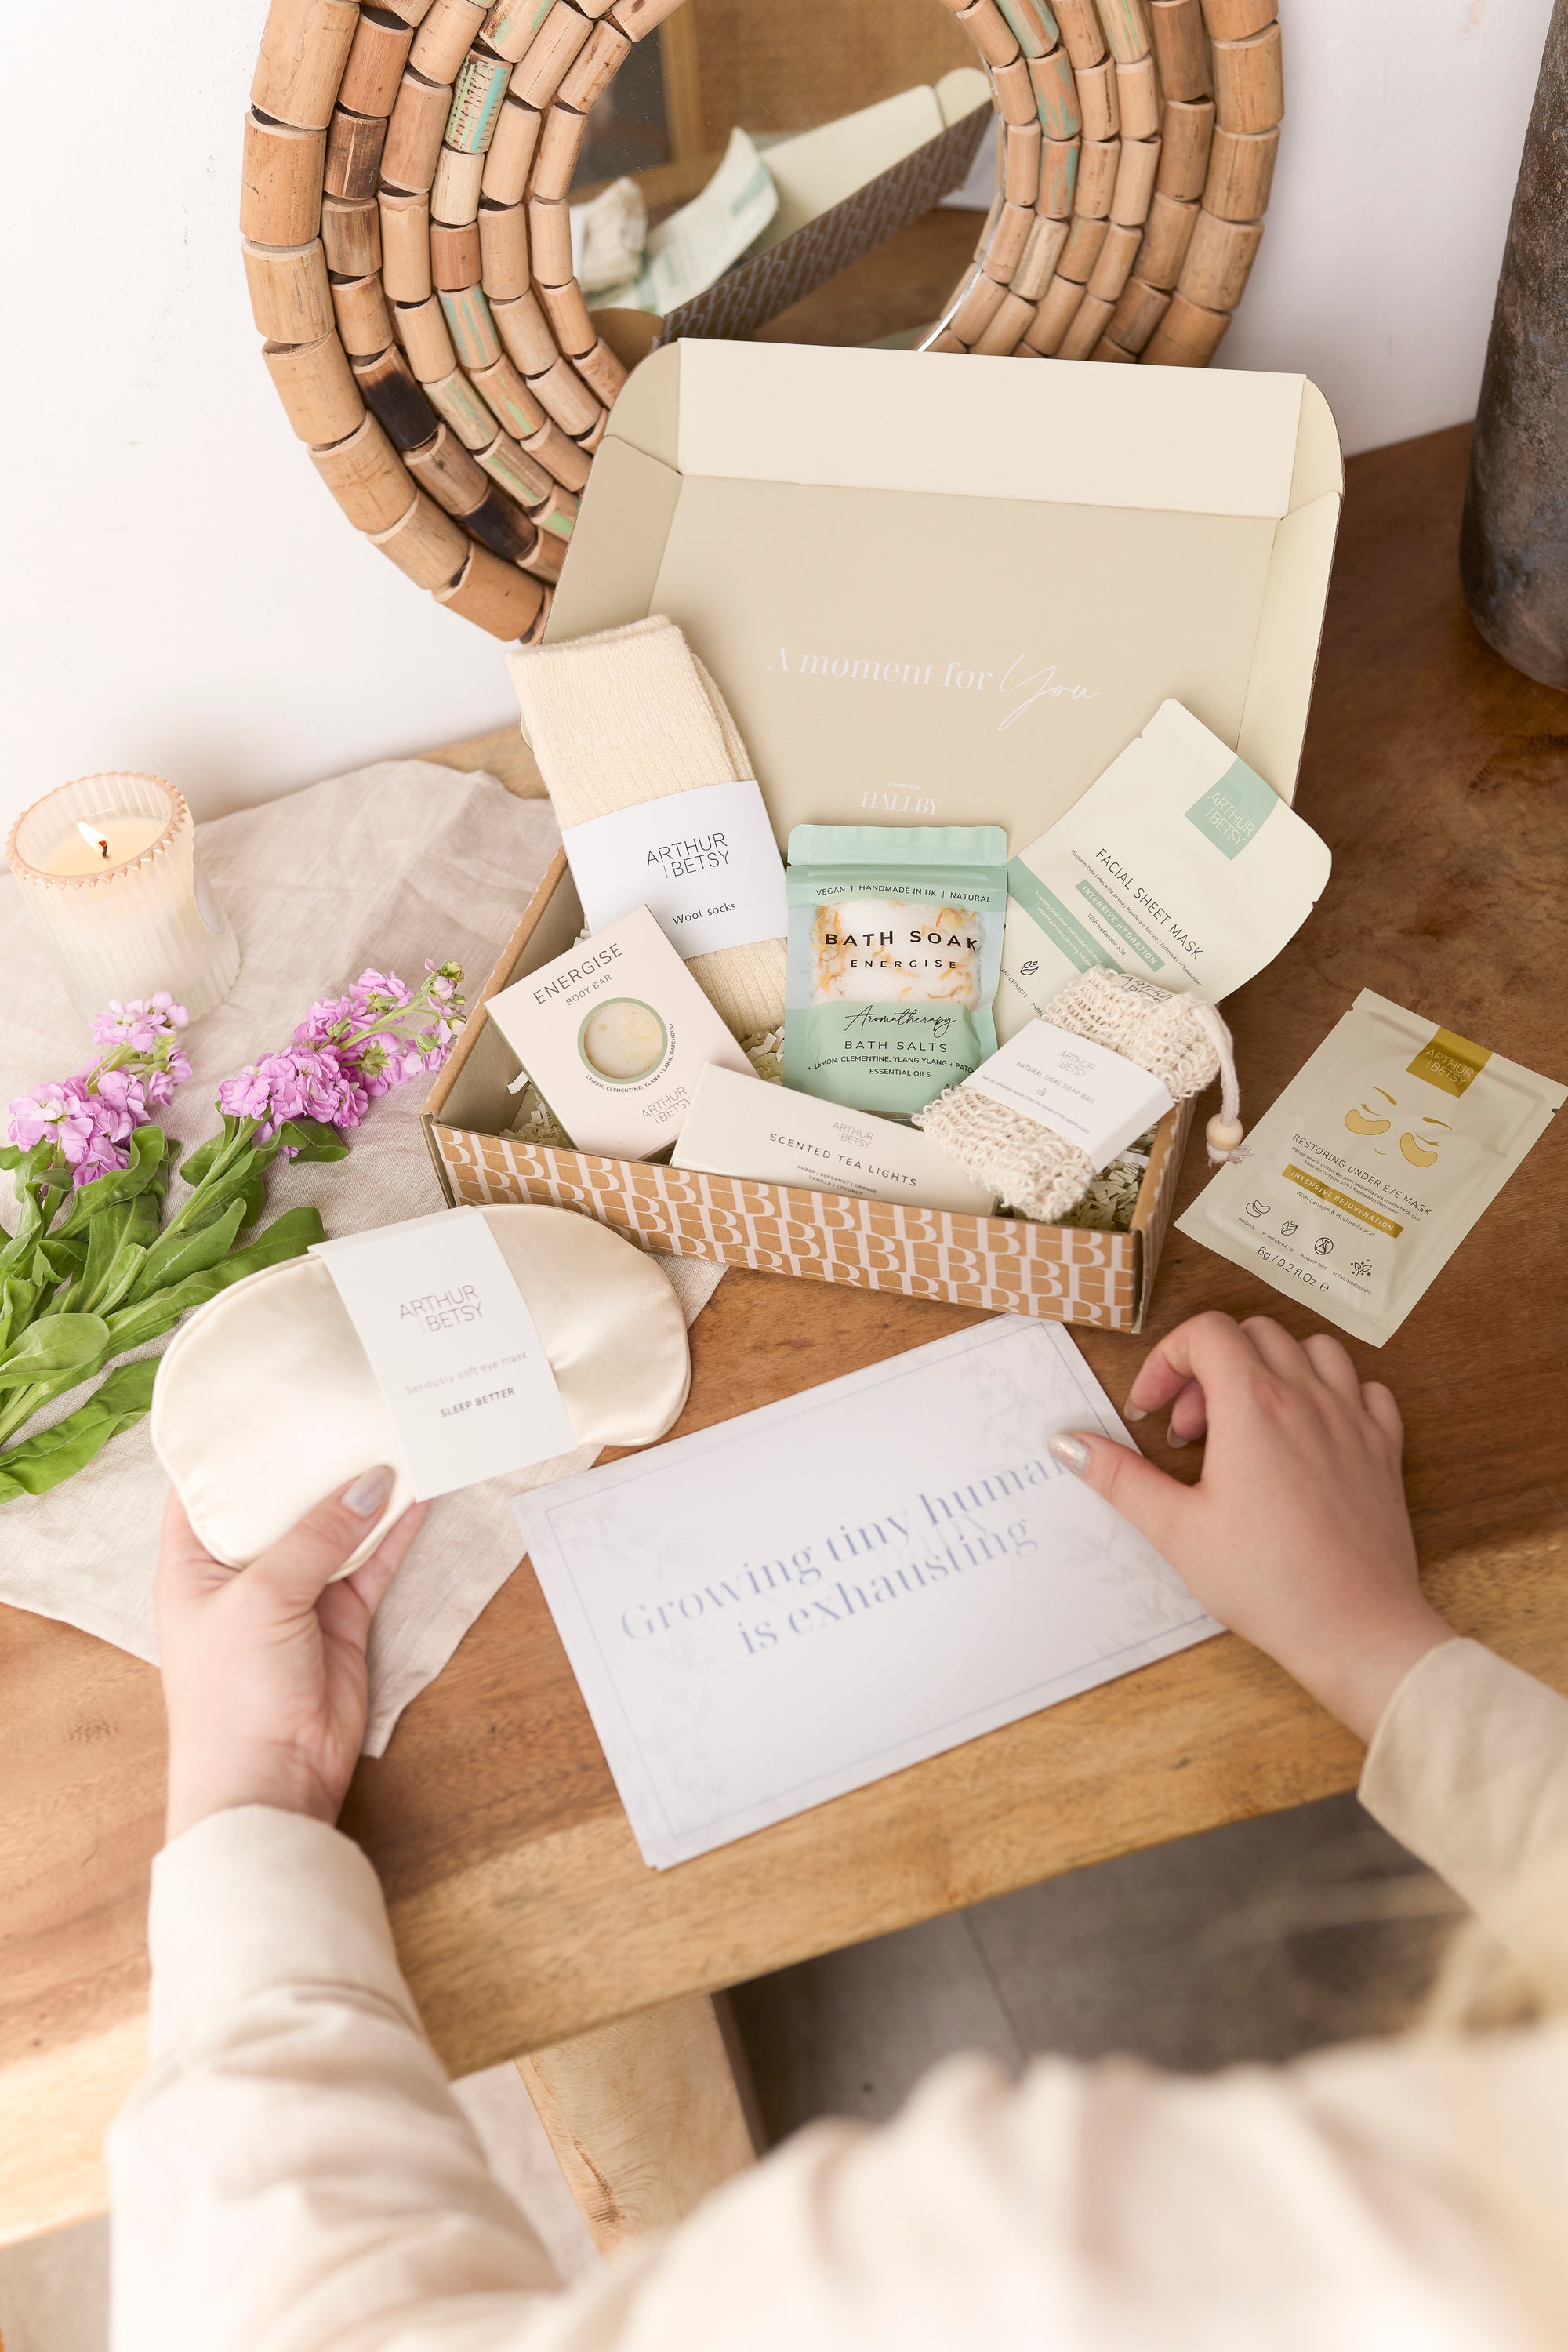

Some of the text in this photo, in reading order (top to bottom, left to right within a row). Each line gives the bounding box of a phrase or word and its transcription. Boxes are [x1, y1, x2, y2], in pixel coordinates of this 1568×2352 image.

[766, 647, 1100, 731] A moment for You
[859, 790, 944, 815] HALLBY
[1208, 792, 1254, 837] ARTHUR
[647, 833, 728, 866] ARTHUR
[815, 886, 845, 896] VEGAN
[858, 884, 910, 894] HANDMADE
[950, 892, 991, 902] NATURAL
[1095, 848, 1203, 960] FACIAL SHEET MASK
[672, 902, 736, 924] Wool socks
[1082, 886, 1118, 921] INTENSIVE
[1116, 922, 1157, 964] HYDRATION
[825, 930, 978, 953] BATH SOAK
[1087, 913, 1127, 956] With Hyaluronic acid
[533, 942, 624, 1004] ENERGISE
[851, 959, 956, 969] ENERGISE
[565, 974, 612, 1006] BODY BAR
[1008, 977, 1029, 998] EXTRACTS
[844, 1004, 957, 1039] Aromatherapy
[844, 1040, 948, 1053] BATH SALTS
[1058, 1051, 1096, 1072] ARTHUR
[814, 1057, 839, 1069] LEMON,
[921, 1058, 947, 1067] YLANG
[869, 1068, 931, 1078] ESSENTIAL OILS
[1059, 1061, 1089, 1077] BETSY
[1425, 1048, 1474, 1078] ARTHUR
[644, 1074, 662, 1087] YLANG
[1016, 1062, 1096, 1105] NATURAL SISAL SOAP BAG
[641, 1086, 688, 1120] ARTHUR
[831, 1122, 874, 1141] ARTHUR
[840, 1133, 873, 1149] BETSY
[769, 1133, 917, 1187] SCENTED TEA LIGHTS
[797, 1165, 877, 1194] AMBER BERGAMOT ORANGE
[808, 1175, 863, 1196] VANILLA COCONUT
[1292, 1134, 1432, 1217] RESTORING UNDER EYE MASK
[1291, 1171, 1394, 1231] INTENSIVE REJUVENATION
[1296, 1190, 1308, 1201] With
[1308, 1198, 1330, 1214] Collagen
[1336, 1213, 1363, 1231] Hyaluronic
[1363, 1228, 1374, 1236] acid
[1238, 1218, 1255, 1229] PATCHES
[1262, 1232, 1294, 1252] PLANT EXTRACTS
[1258, 1247, 1271, 1261] 6g
[1277, 1258, 1294, 1273] 0.2
[1294, 1268, 1317, 1287] fl.Oz
[1301, 1254, 1319, 1265] PARABEN
[1333, 1272, 1371, 1296] ACTIVE INGREDIENTS
[400, 1284, 479, 1320] ARTHUR
[425, 1301, 483, 1332] BETSY
[405, 1351, 528, 1396] Seriously soft eye mask
[440, 1387, 515, 1417] SLEEP BETTER
[621, 1544, 823, 1640] Growing
[825, 1509, 909, 1563] tiny
[735, 1619, 779, 1656] is
[787, 1517, 1040, 1637] exhausting
